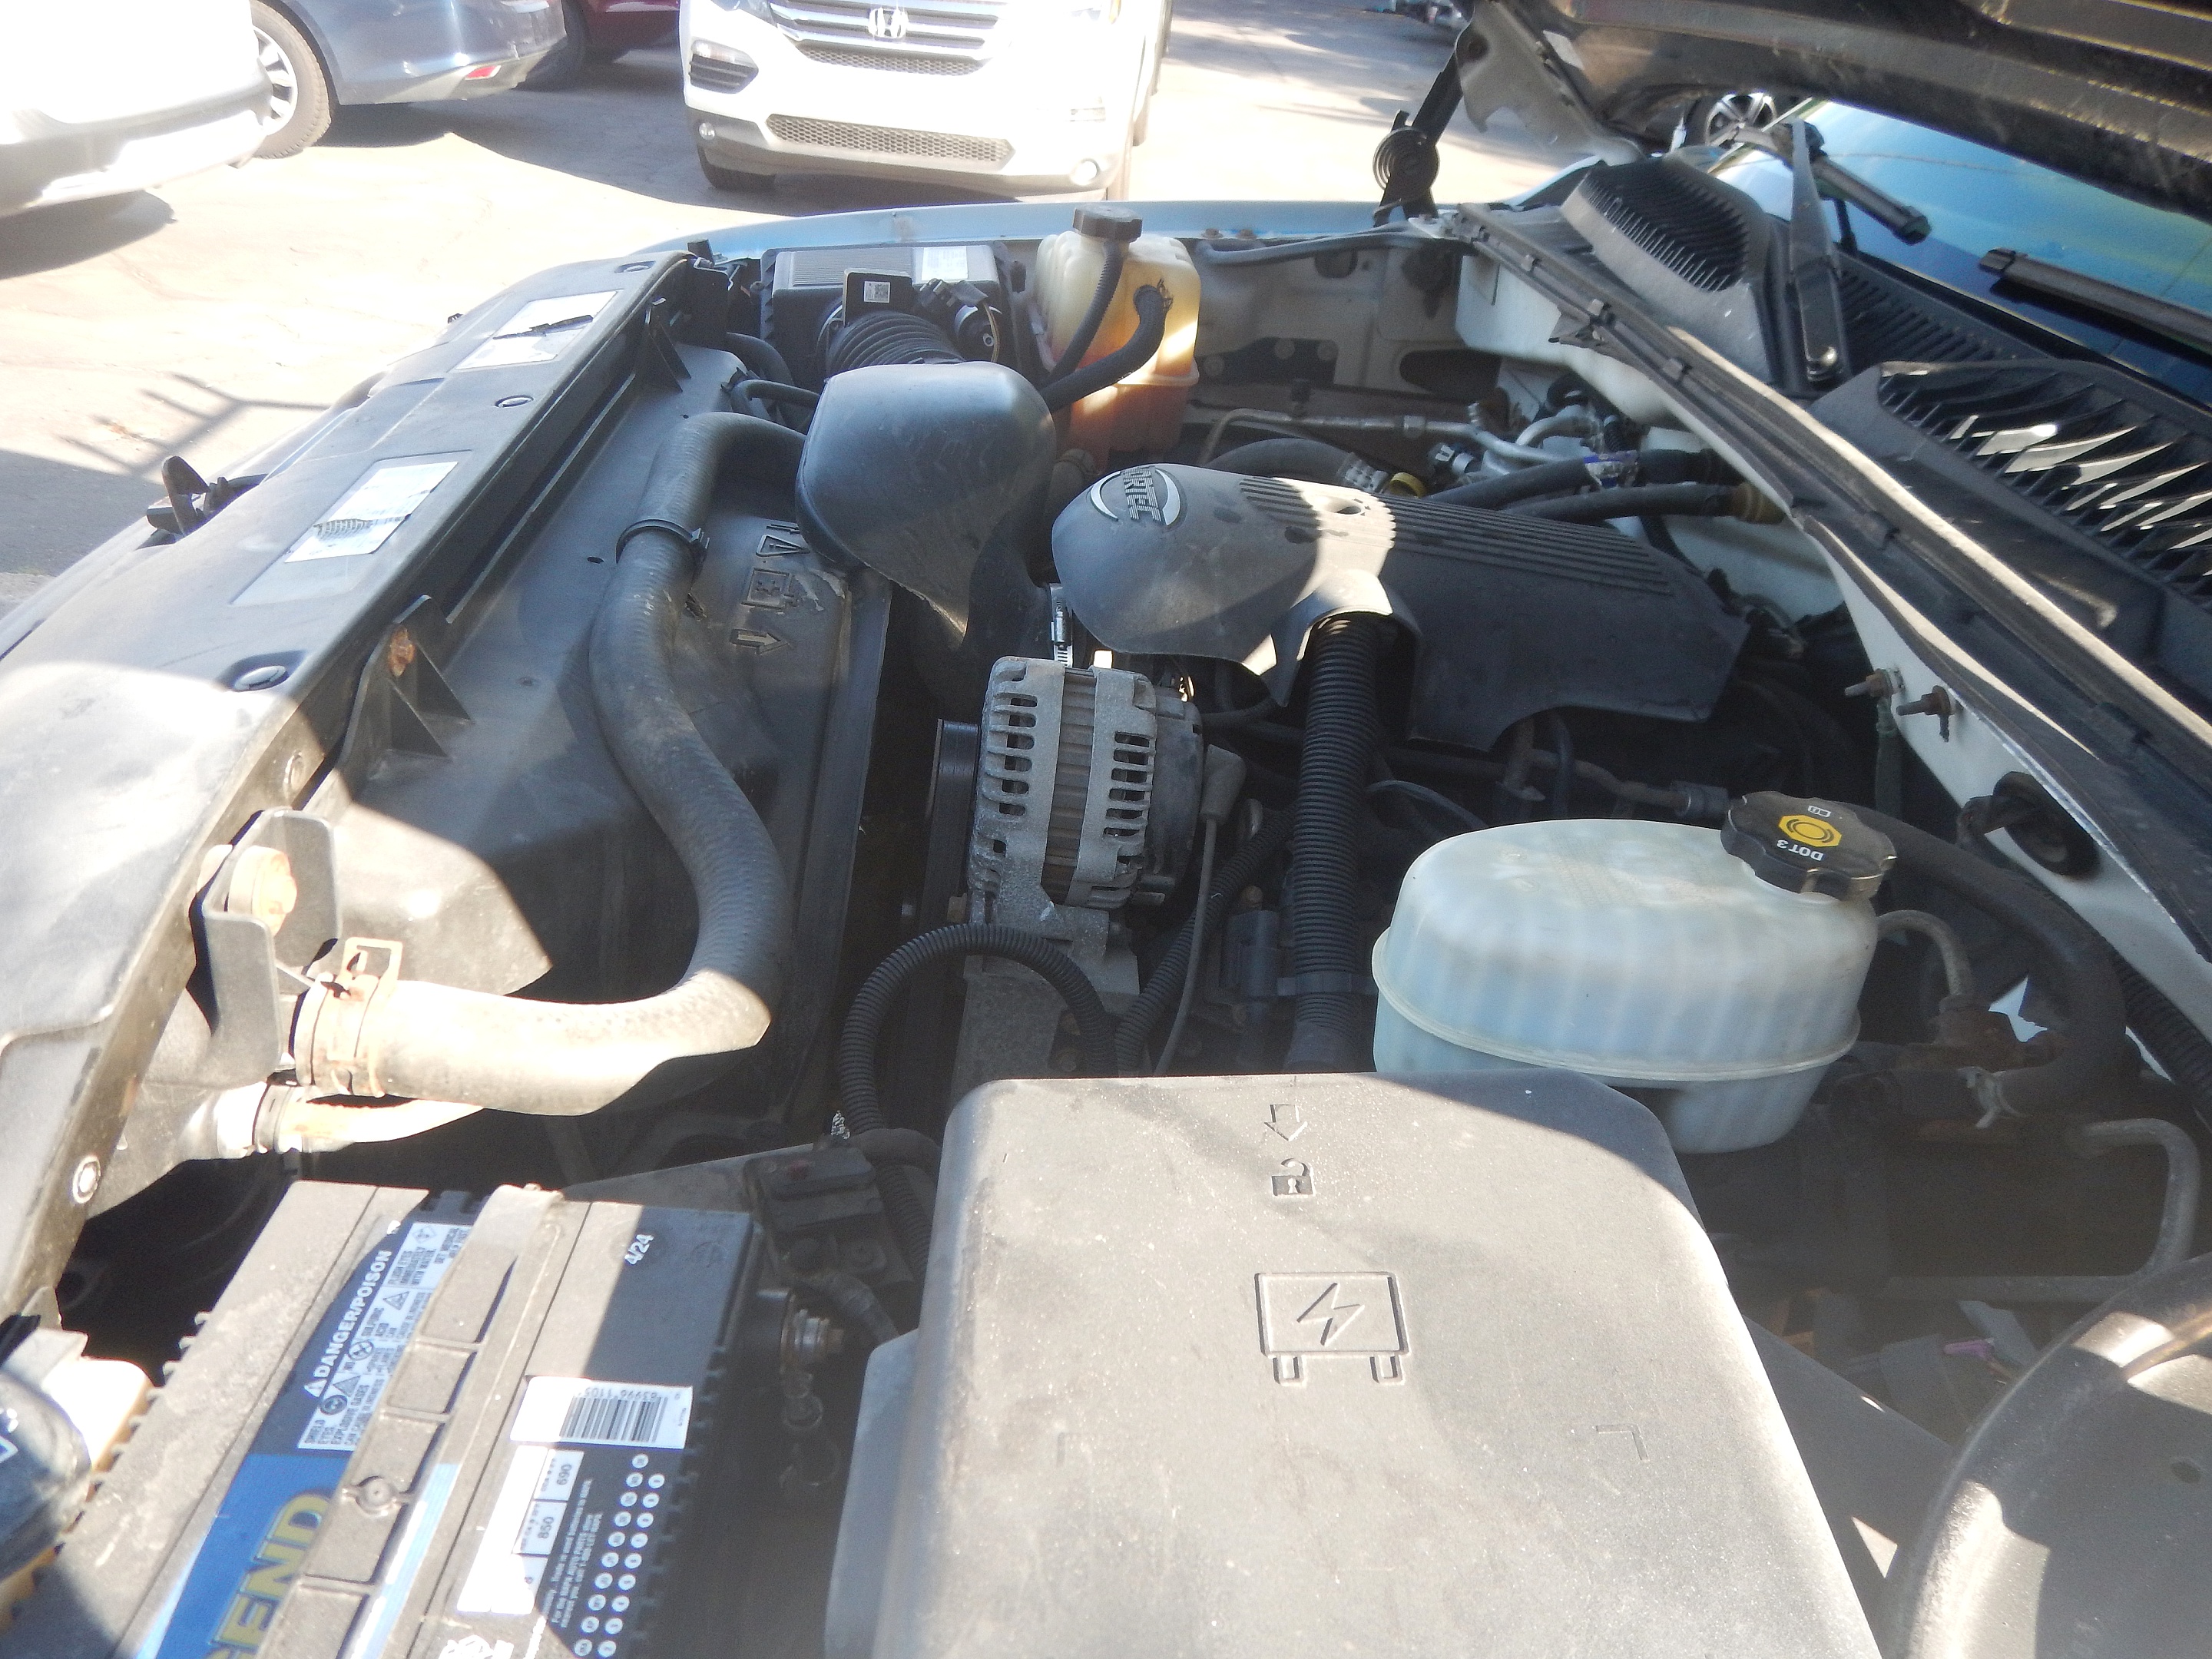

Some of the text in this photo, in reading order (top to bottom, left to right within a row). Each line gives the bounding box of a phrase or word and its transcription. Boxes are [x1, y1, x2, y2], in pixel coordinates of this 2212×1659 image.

[1777, 839, 1823, 861] DOT 3
[624, 1234, 654, 1265] 4/24
[312, 1250, 394, 1376] DANGER/POISON
[205, 1491, 333, 1659] END
